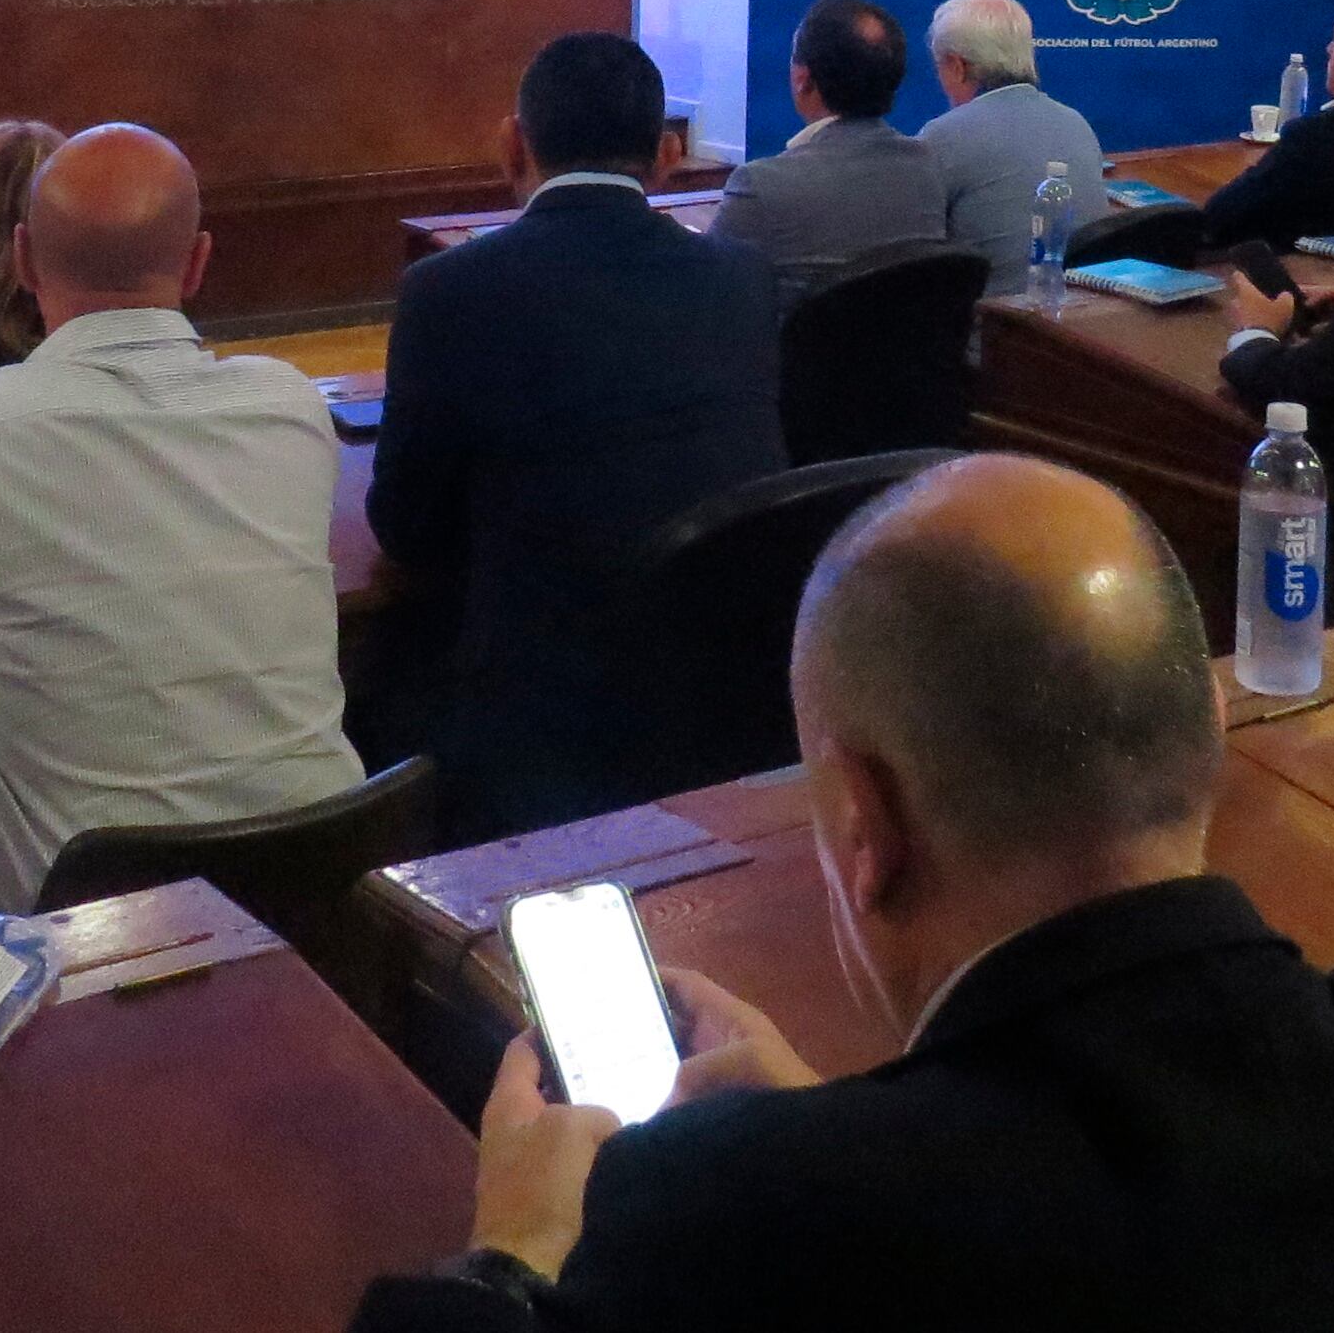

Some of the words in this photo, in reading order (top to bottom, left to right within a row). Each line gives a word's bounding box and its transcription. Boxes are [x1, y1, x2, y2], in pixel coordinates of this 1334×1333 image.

[1091, 38, 1112, 48] DEL
[1156, 38, 1219, 48] ARGENTINO
[1280, 517, 1306, 607] smart
